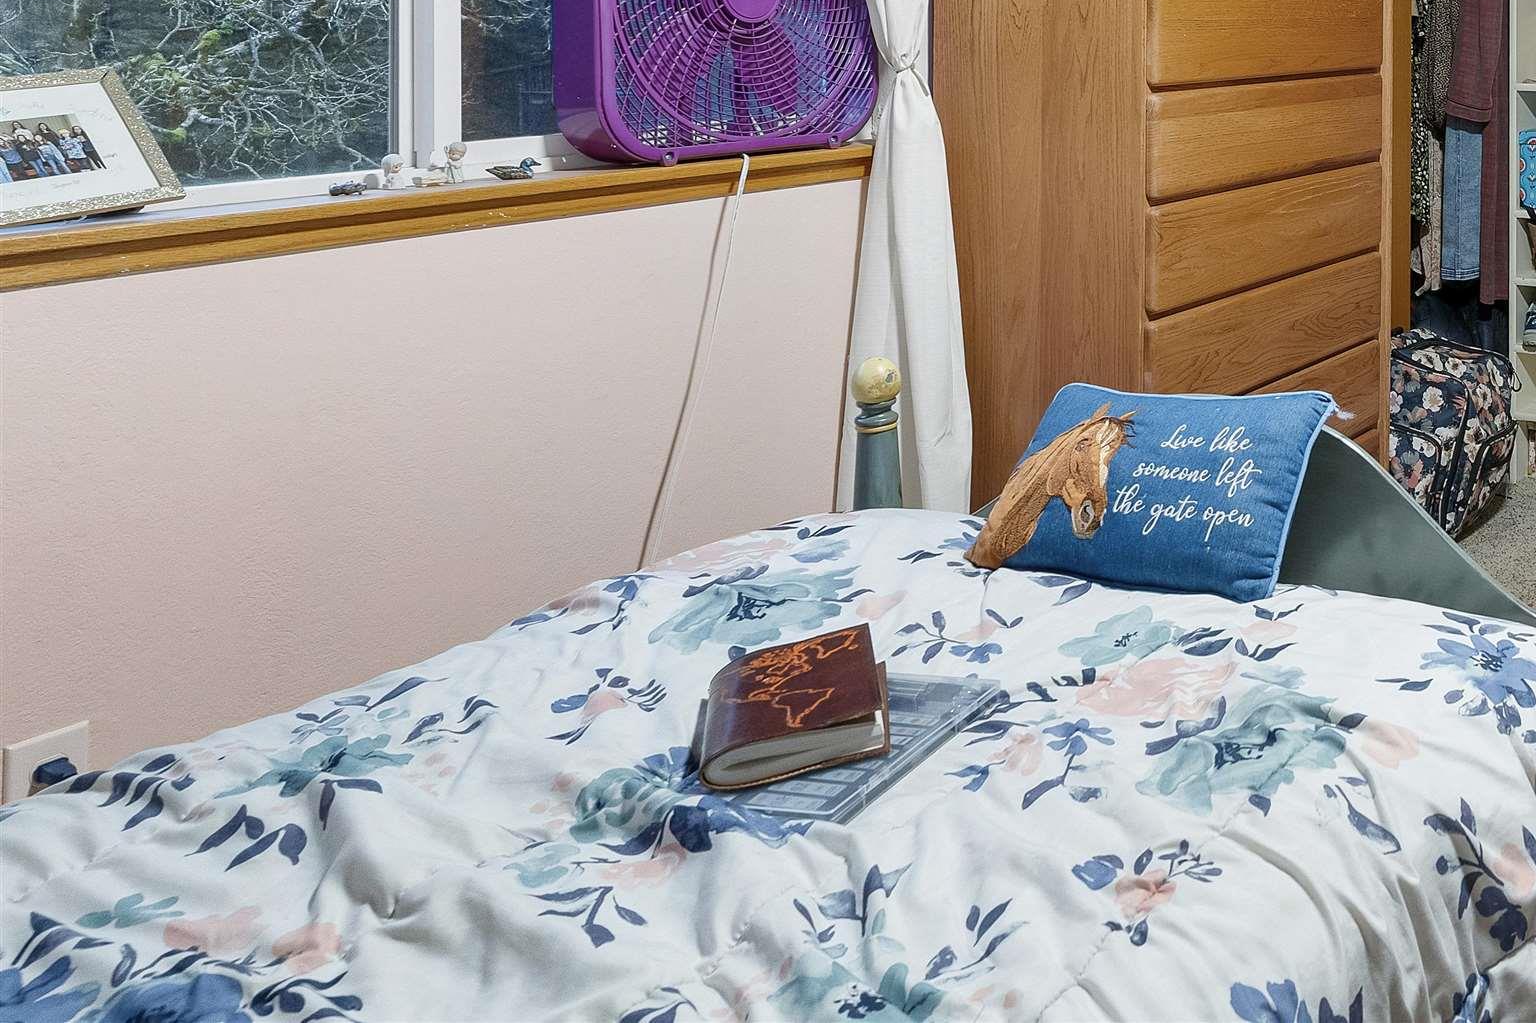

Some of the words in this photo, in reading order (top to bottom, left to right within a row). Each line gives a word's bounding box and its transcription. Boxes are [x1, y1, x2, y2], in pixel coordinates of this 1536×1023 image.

[1160, 424, 1205, 451] Live
[1209, 425, 1252, 453] like
[1133, 461, 1212, 482] someone
[1216, 458, 1263, 498] left
[1112, 484, 1145, 514] the
[1142, 495, 1198, 536] gate
[1203, 506, 1255, 543] open
